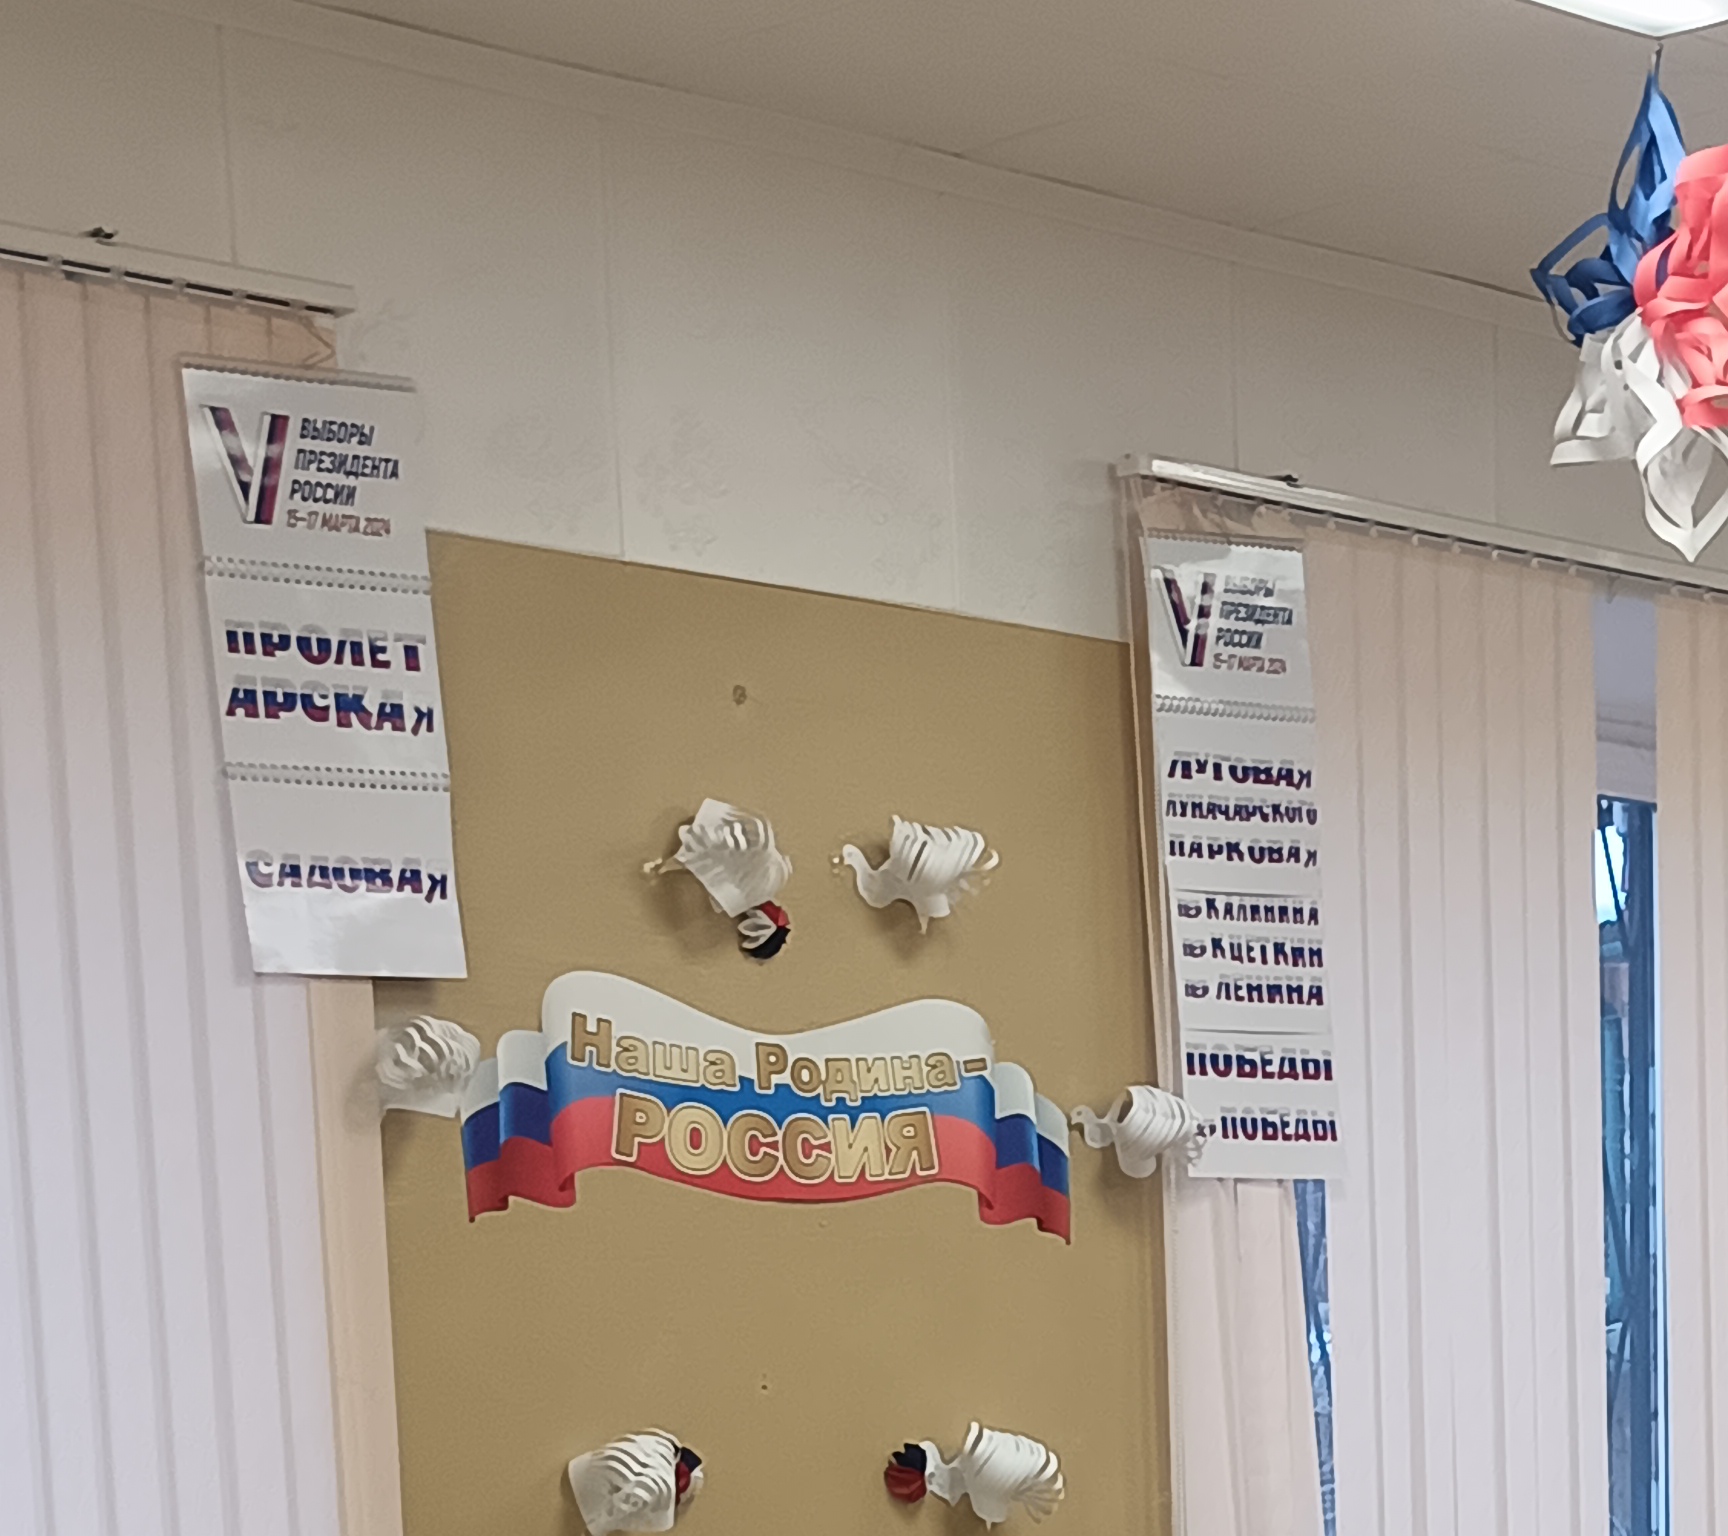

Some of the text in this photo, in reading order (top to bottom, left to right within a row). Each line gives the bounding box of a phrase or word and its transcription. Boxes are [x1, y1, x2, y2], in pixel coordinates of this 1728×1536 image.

[299, 417, 375, 446] ВЫБОРЫ
[294, 448, 399, 480] ПРЕЗИДЕНТА
[289, 479, 357, 507] РОССИИ
[224, 619, 426, 672] ПРОЛЕТ
[225, 674, 435, 737] АРСКАЯ
[1167, 751, 1312, 790] ЛУГОВАЯ
[1169, 833, 1318, 868] ПАРКОВАЯ
[244, 849, 448, 903] САДОВАЯ
[569, 1012, 738, 1090] Наша
[1185, 1042, 1334, 1082] ПОБЕДЫ
[612, 1093, 938, 1181] РОССИЯ
[1220, 1106, 1338, 1143] ПОБЕДЫ
